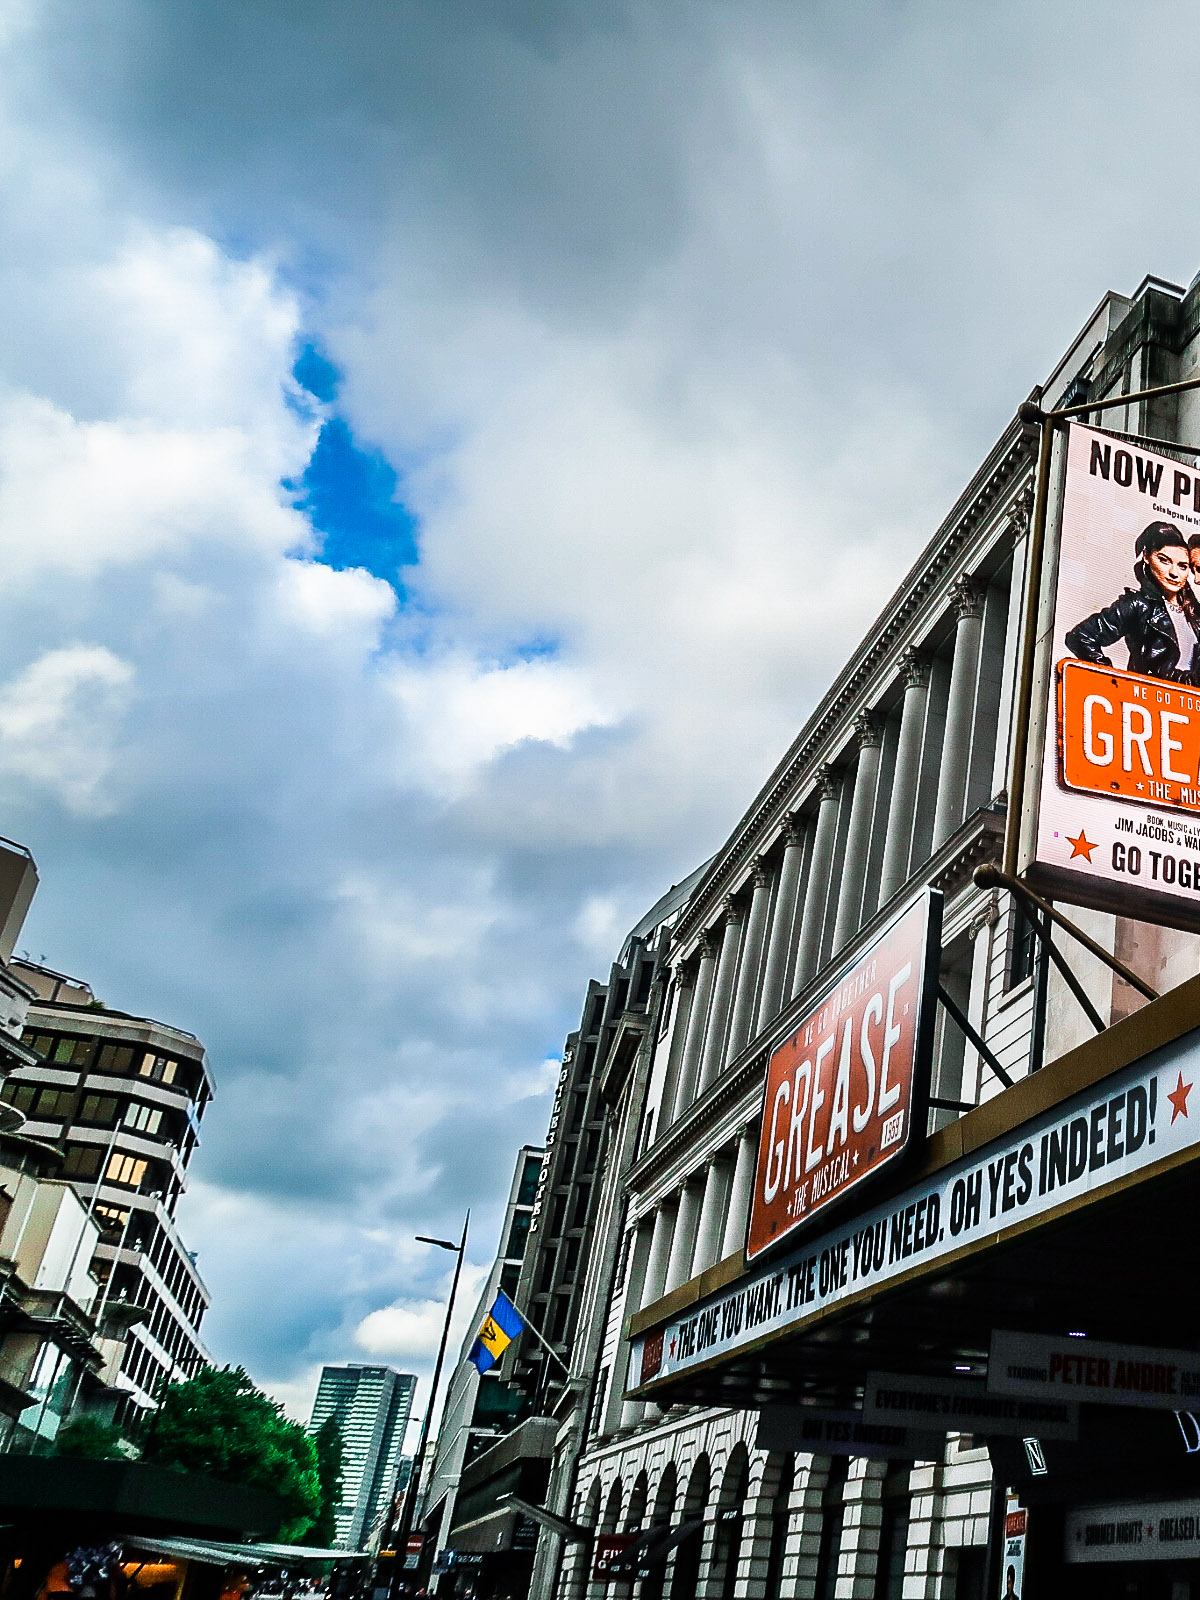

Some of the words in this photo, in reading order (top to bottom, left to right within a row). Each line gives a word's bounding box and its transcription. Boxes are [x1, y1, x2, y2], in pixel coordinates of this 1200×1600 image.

[1089, 439, 1164, 498] NOW
[1133, 685, 1148, 700] WE
[1156, 691, 1171, 705] GO
[1148, 780, 1172, 801] THE
[1115, 817, 1133, 833] JIM
[1136, 823, 1174, 845] JACOBS
[1177, 837, 1182, 846] &
[1167, 820, 1188, 834] MUSIC
[1111, 841, 1141, 876] GO
[764, 962, 911, 1204] GREASE
[529, 1151, 553, 1232] HOTEL
[792, 1181, 810, 1219] THE
[811, 1149, 850, 1205] MUSICAL
[676, 1320, 697, 1361] THE
[697, 1304, 720, 1352] ONE
[720, 1291, 744, 1342] YOU
[786, 1258, 818, 1311] THE
[818, 1239, 850, 1299] ONE
[852, 1217, 887, 1282] YOU
[889, 1192, 944, 1265] NEED.
[950, 1168, 982, 1237] OH
[988, 1143, 1033, 1219] YES
[1038, 1075, 1157, 1197] INDEED!
[1050, 1353, 1110, 1388] PETER
[1113, 1360, 1177, 1394] ANDRE
[827, 1422, 850, 1441] YES
[1027, 1443, 1043, 1469] N
[1085, 1523, 1115, 1546] SUMMER
[1159, 1516, 1194, 1542] GREASED
